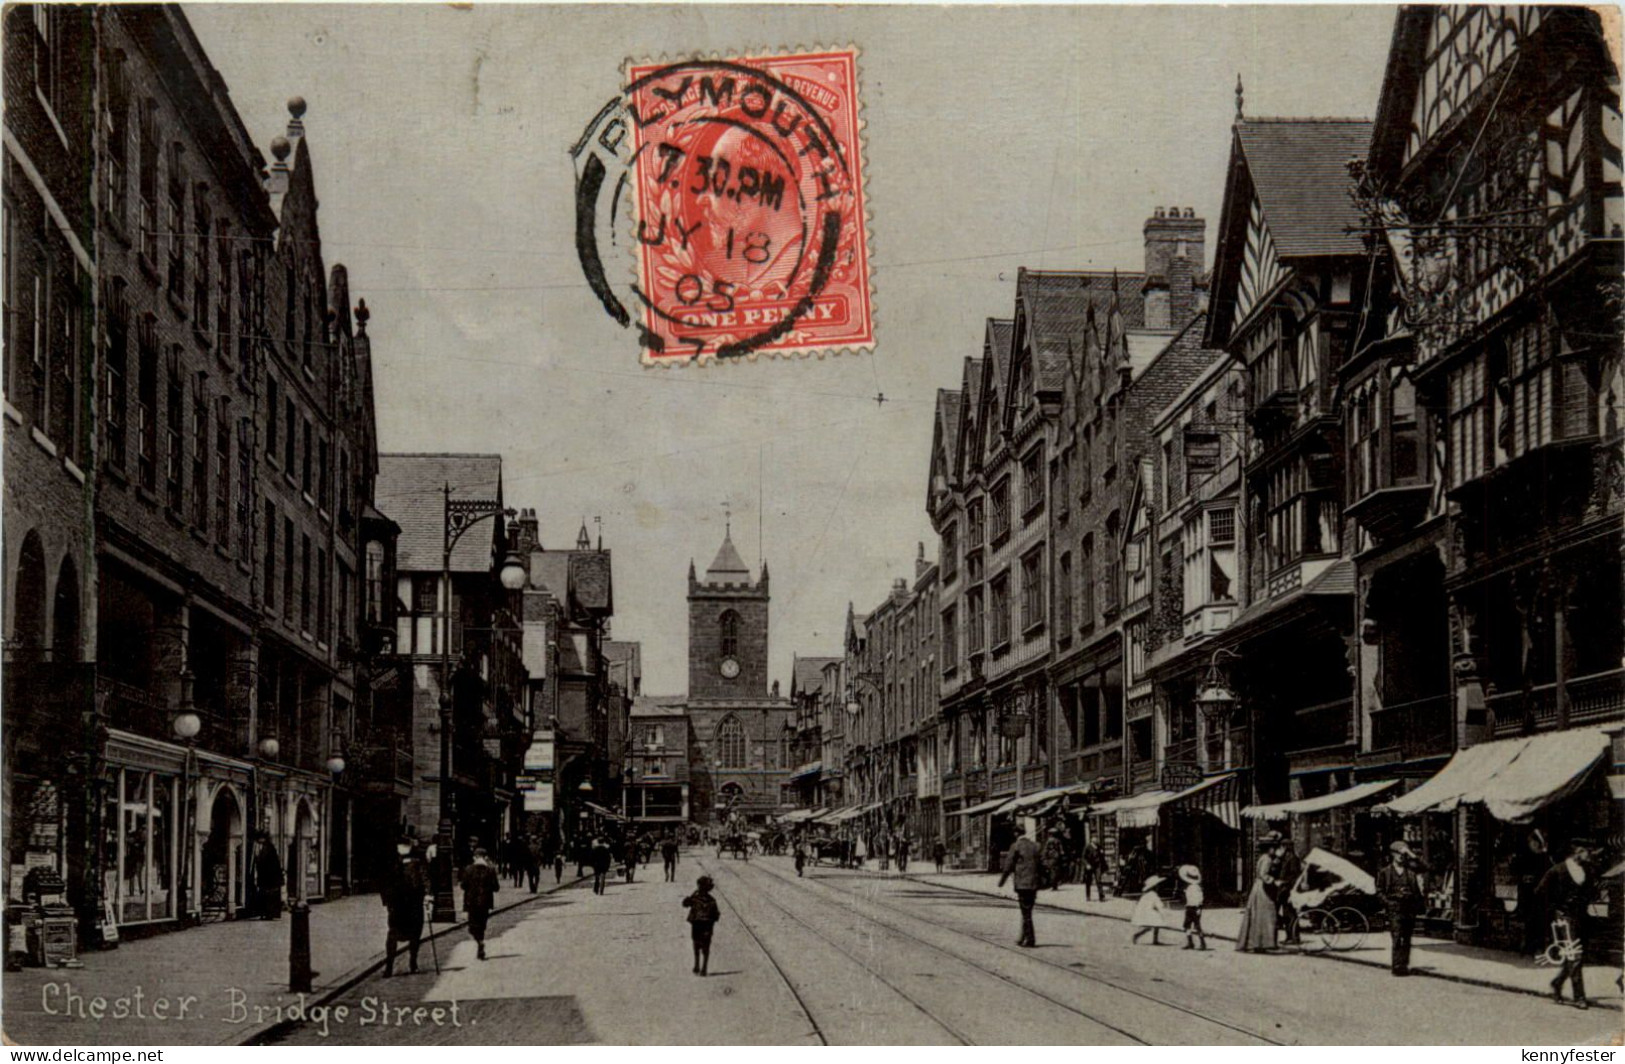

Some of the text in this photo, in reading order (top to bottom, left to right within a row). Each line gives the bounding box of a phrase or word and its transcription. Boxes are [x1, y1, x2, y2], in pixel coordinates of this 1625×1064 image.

[793, 79, 837, 110] REVENUE
[598, 75, 840, 201] PLYMOUTH
[726, 227, 771, 264] 18
[675, 273, 735, 312] 05
[680, 312, 738, 328] ONE
